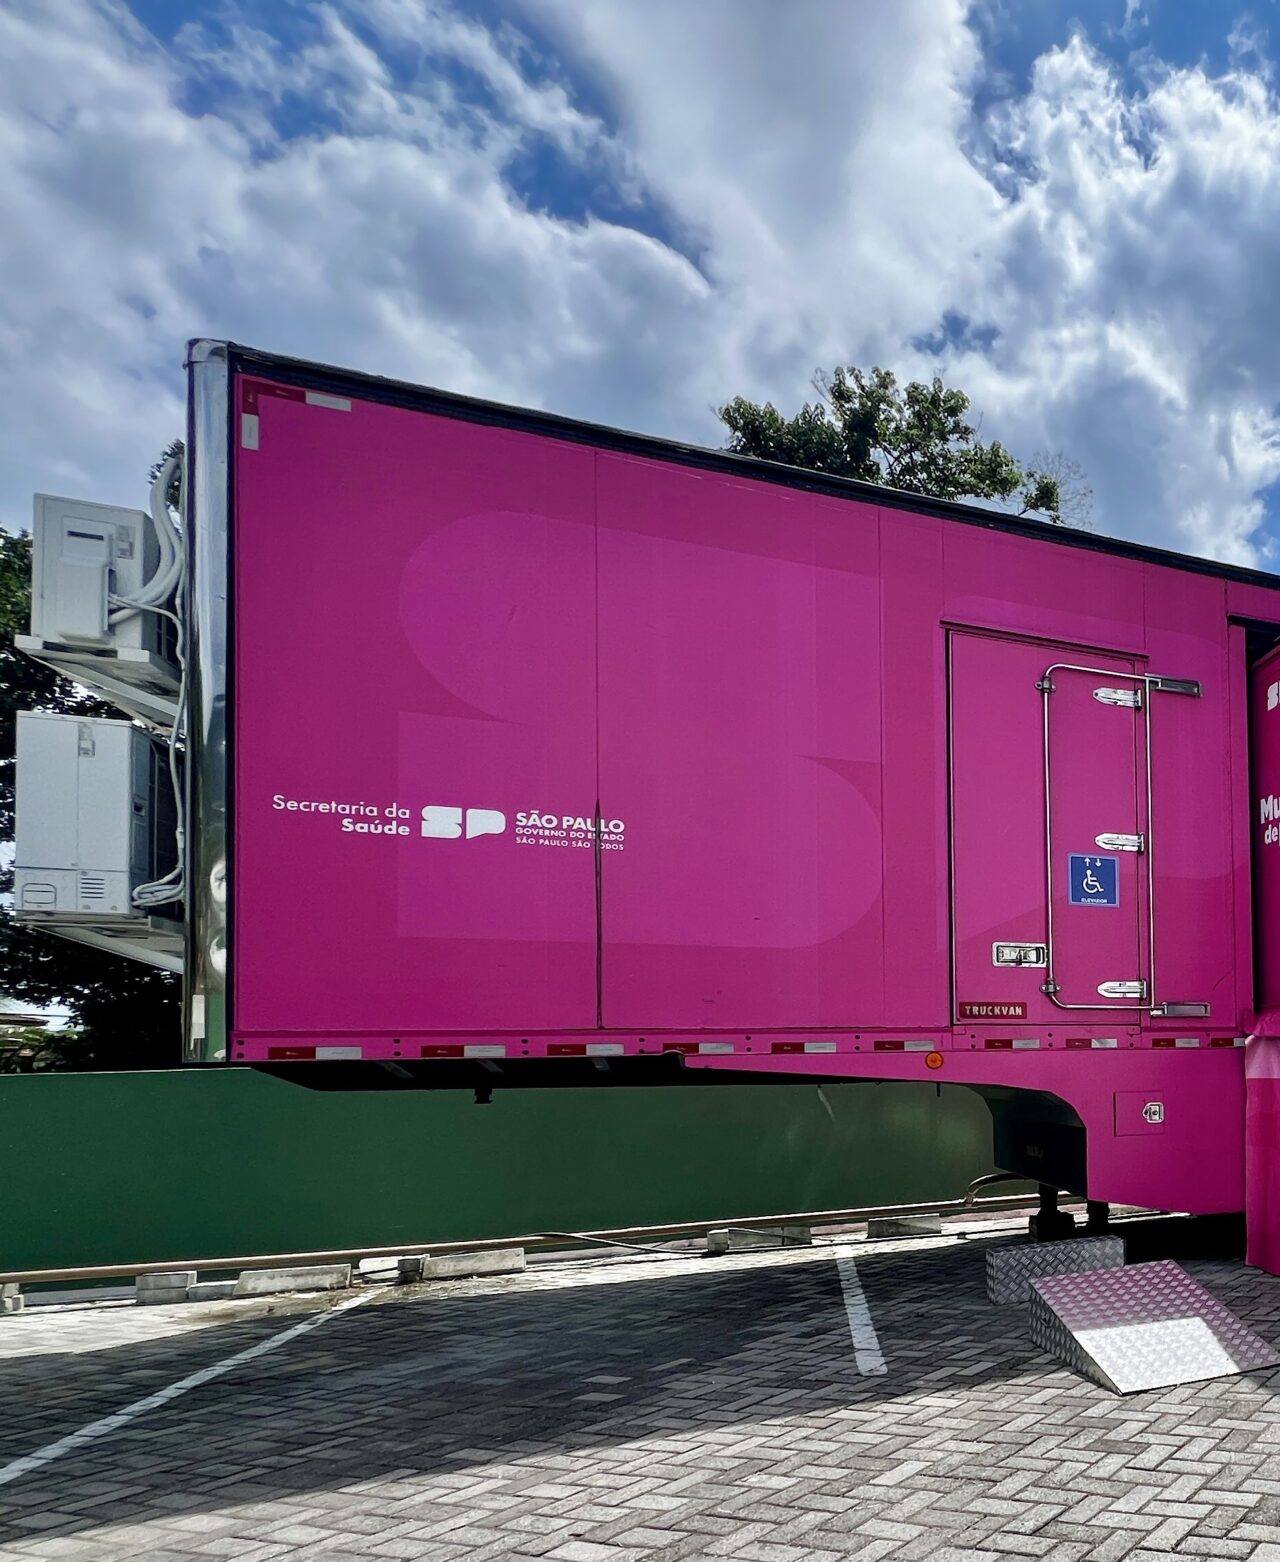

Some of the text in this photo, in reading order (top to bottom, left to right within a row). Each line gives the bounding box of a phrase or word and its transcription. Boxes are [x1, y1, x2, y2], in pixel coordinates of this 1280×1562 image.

[272, 794, 410, 819] Secretaria da
[516, 810, 558, 828] SÃO
[341, 818, 410, 836] Saúde
[515, 827, 566, 837] GOVERNO
[569, 831, 585, 839] DO
[515, 836, 536, 845] SÃO
[539, 839, 569, 847] PAULO
[572, 840, 591, 848] SÃO
[964, 1006, 1023, 1016] TRUCKVAN
